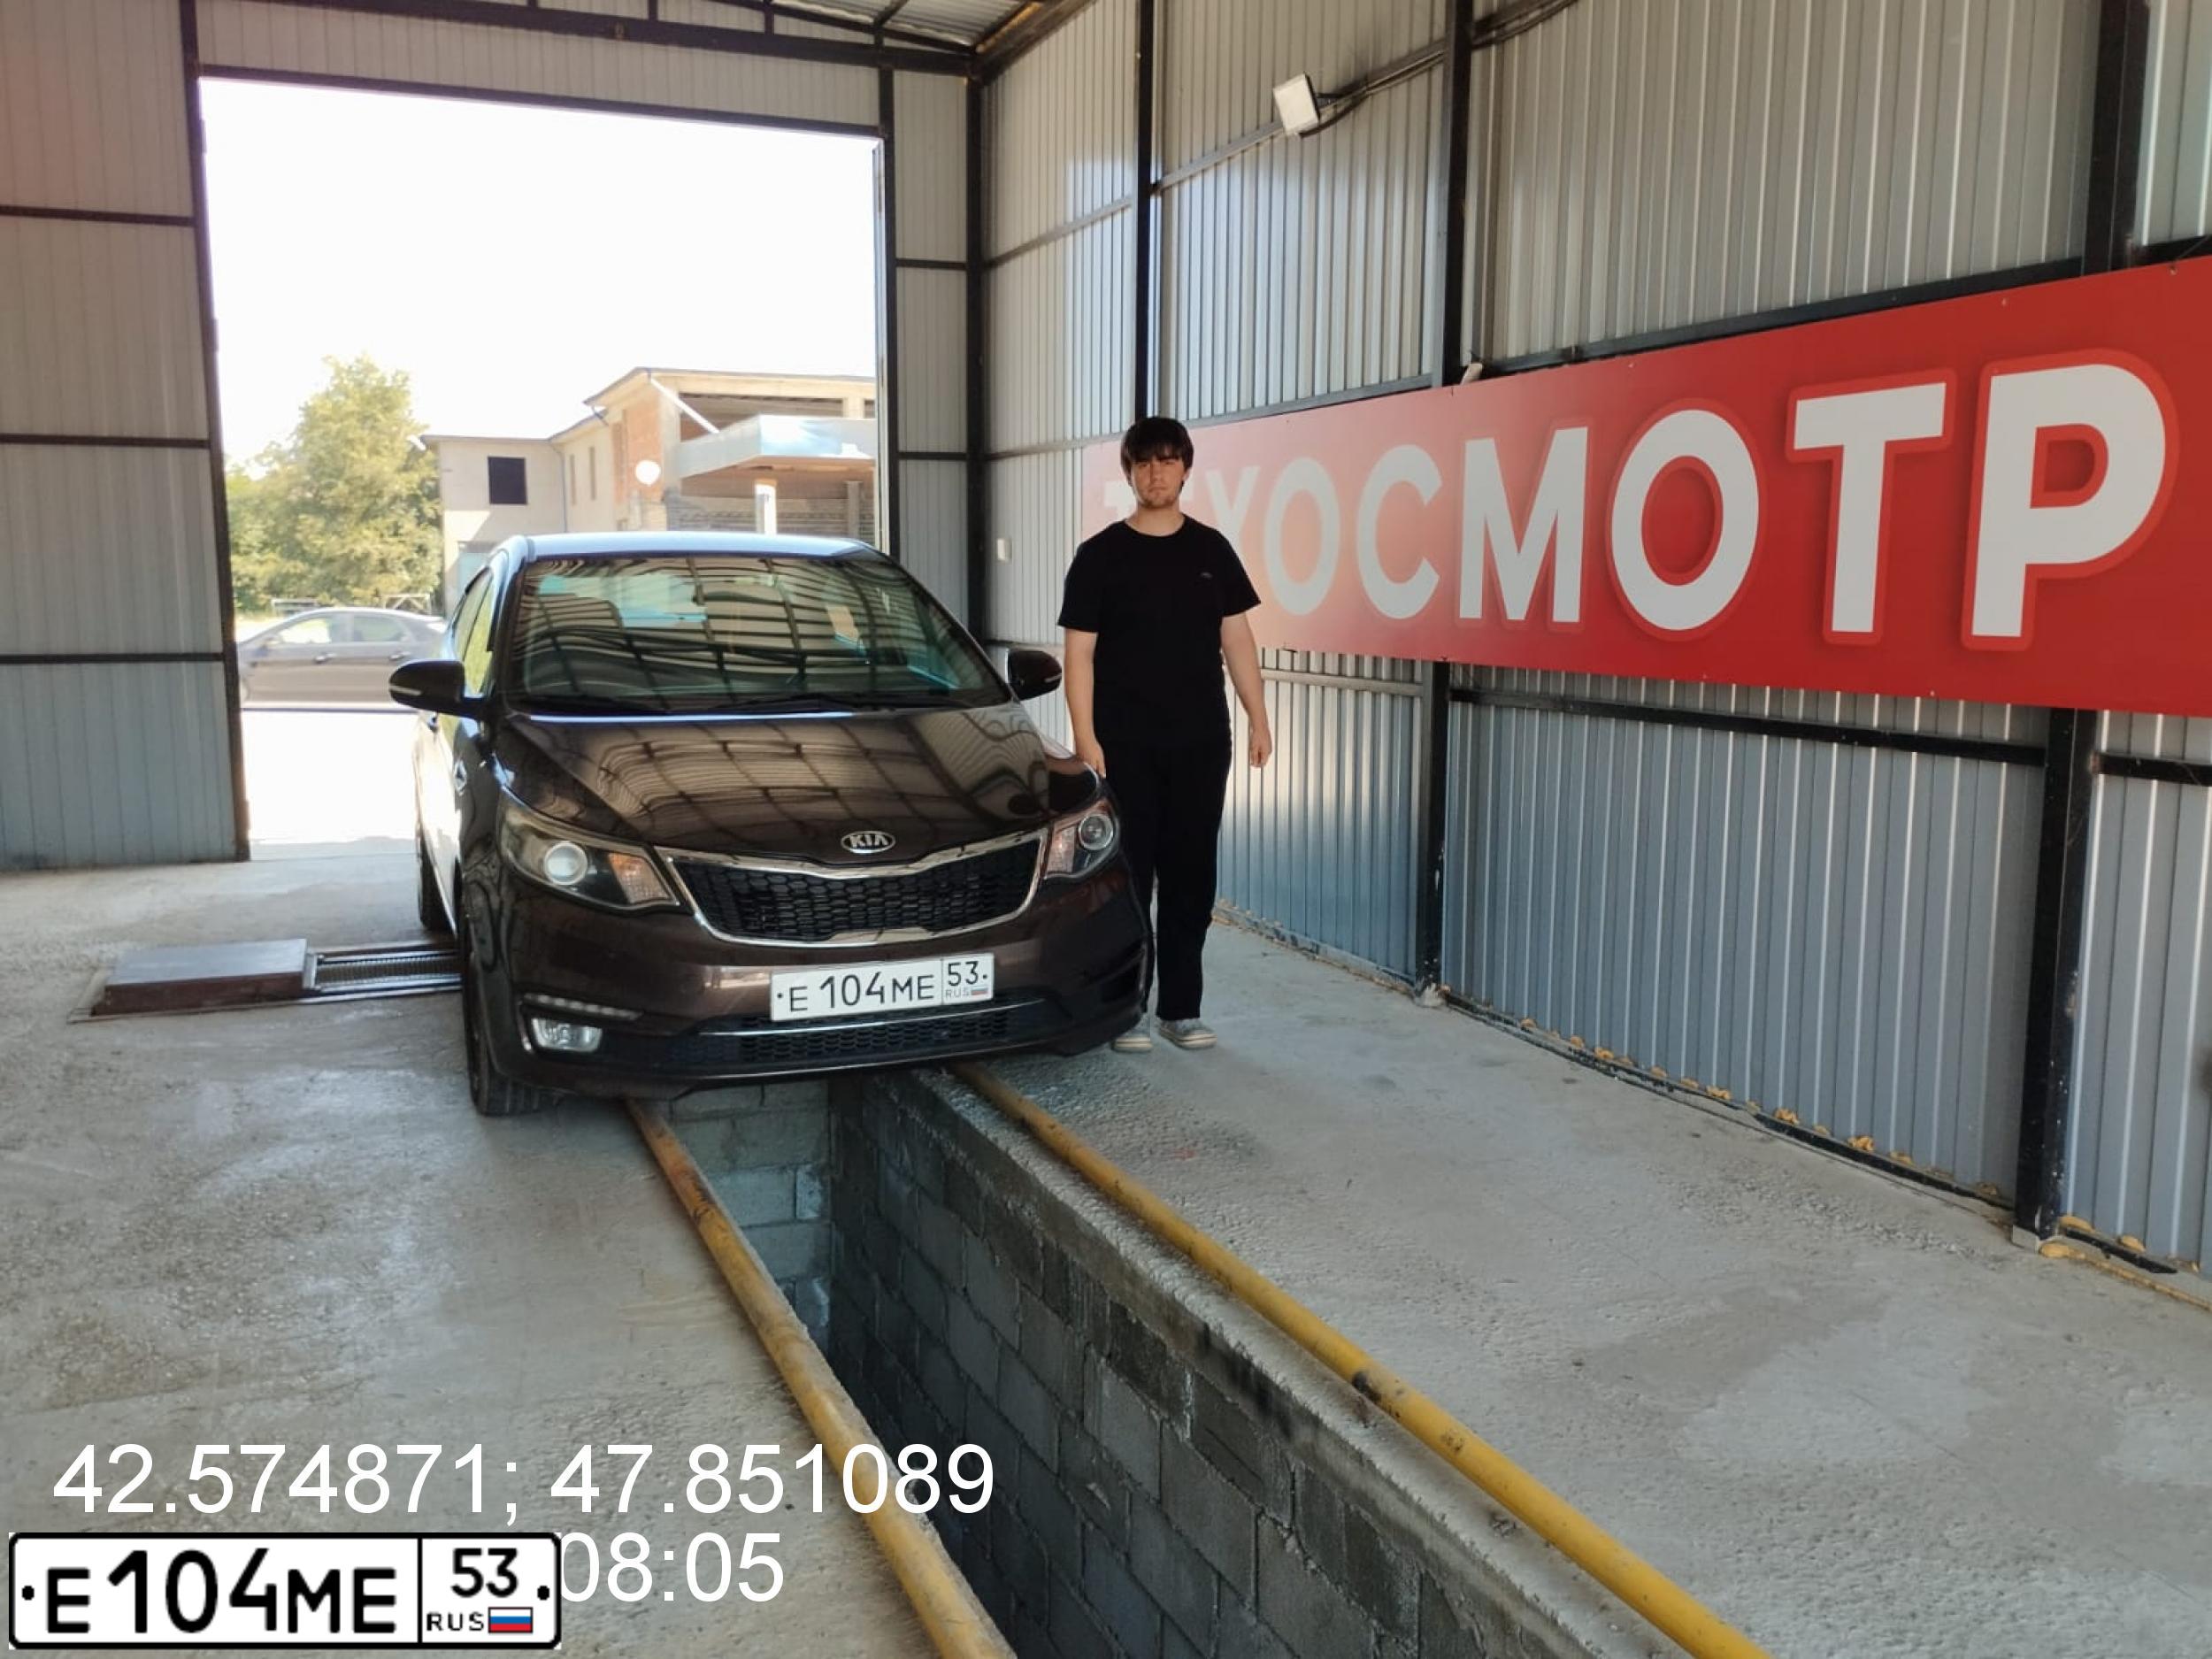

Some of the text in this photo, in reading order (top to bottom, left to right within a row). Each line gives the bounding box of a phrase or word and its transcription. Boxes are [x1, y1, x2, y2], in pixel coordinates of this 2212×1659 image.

[849, 834, 888, 849] KIA
[947, 960, 979, 987] 53
[944, 987, 971, 999] RUS
